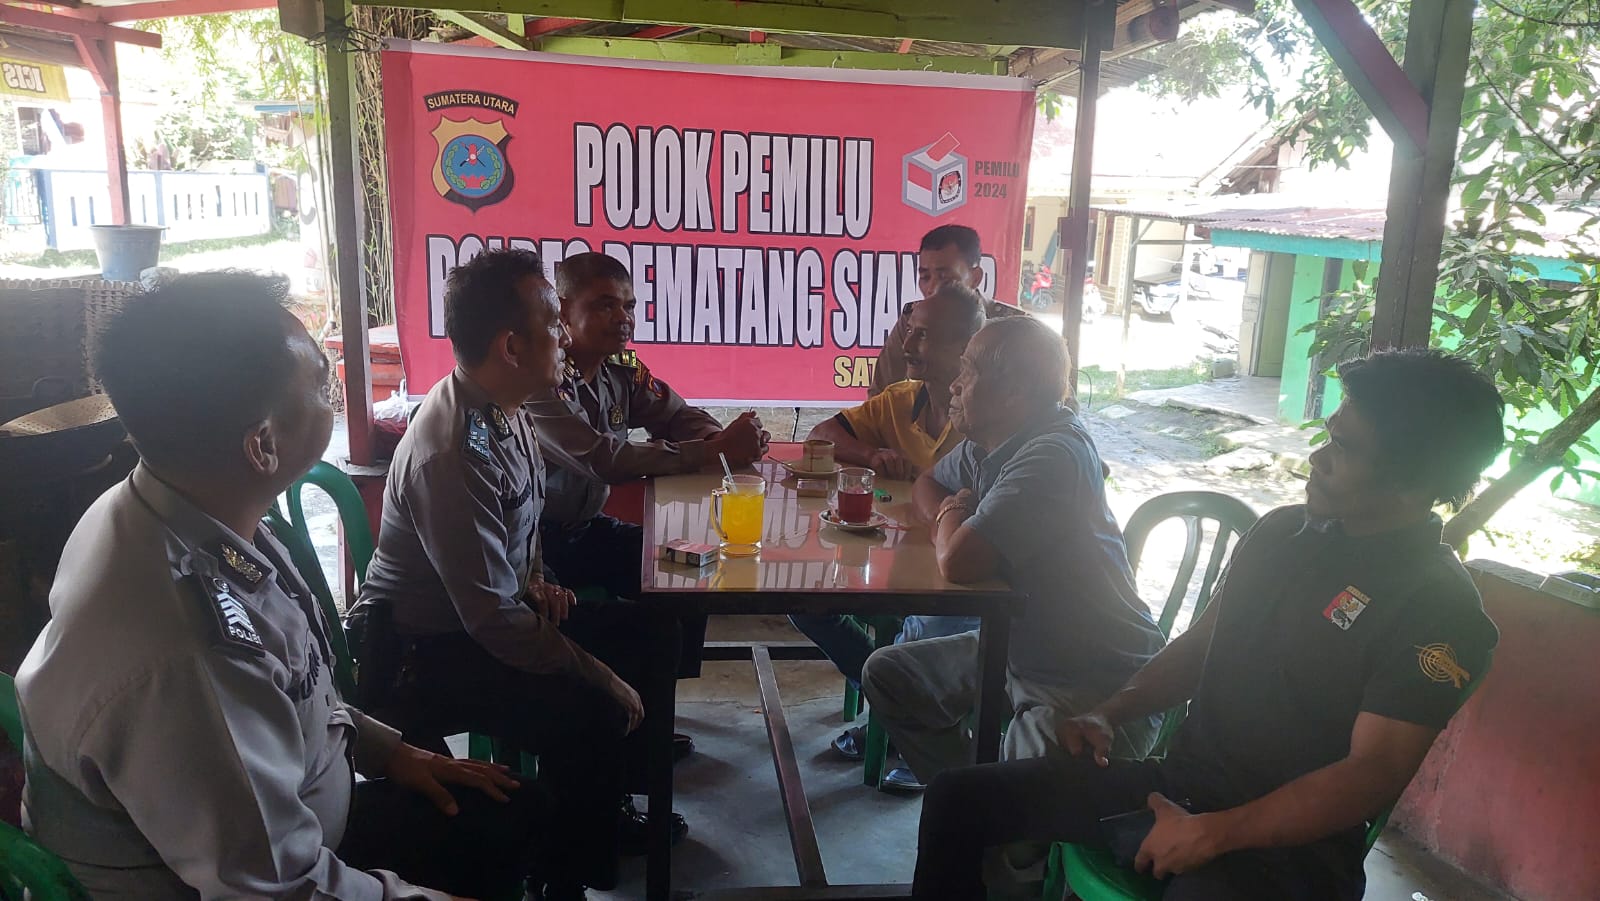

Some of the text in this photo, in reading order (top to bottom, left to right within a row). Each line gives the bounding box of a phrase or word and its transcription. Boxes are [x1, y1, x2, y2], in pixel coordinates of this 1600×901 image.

[427, 93, 515, 115] SUMATERA UTARA
[974, 160, 1019, 177] PEMILU
[574, 122, 873, 239] POJOK PEMILU
[974, 182, 1007, 199] 2024
